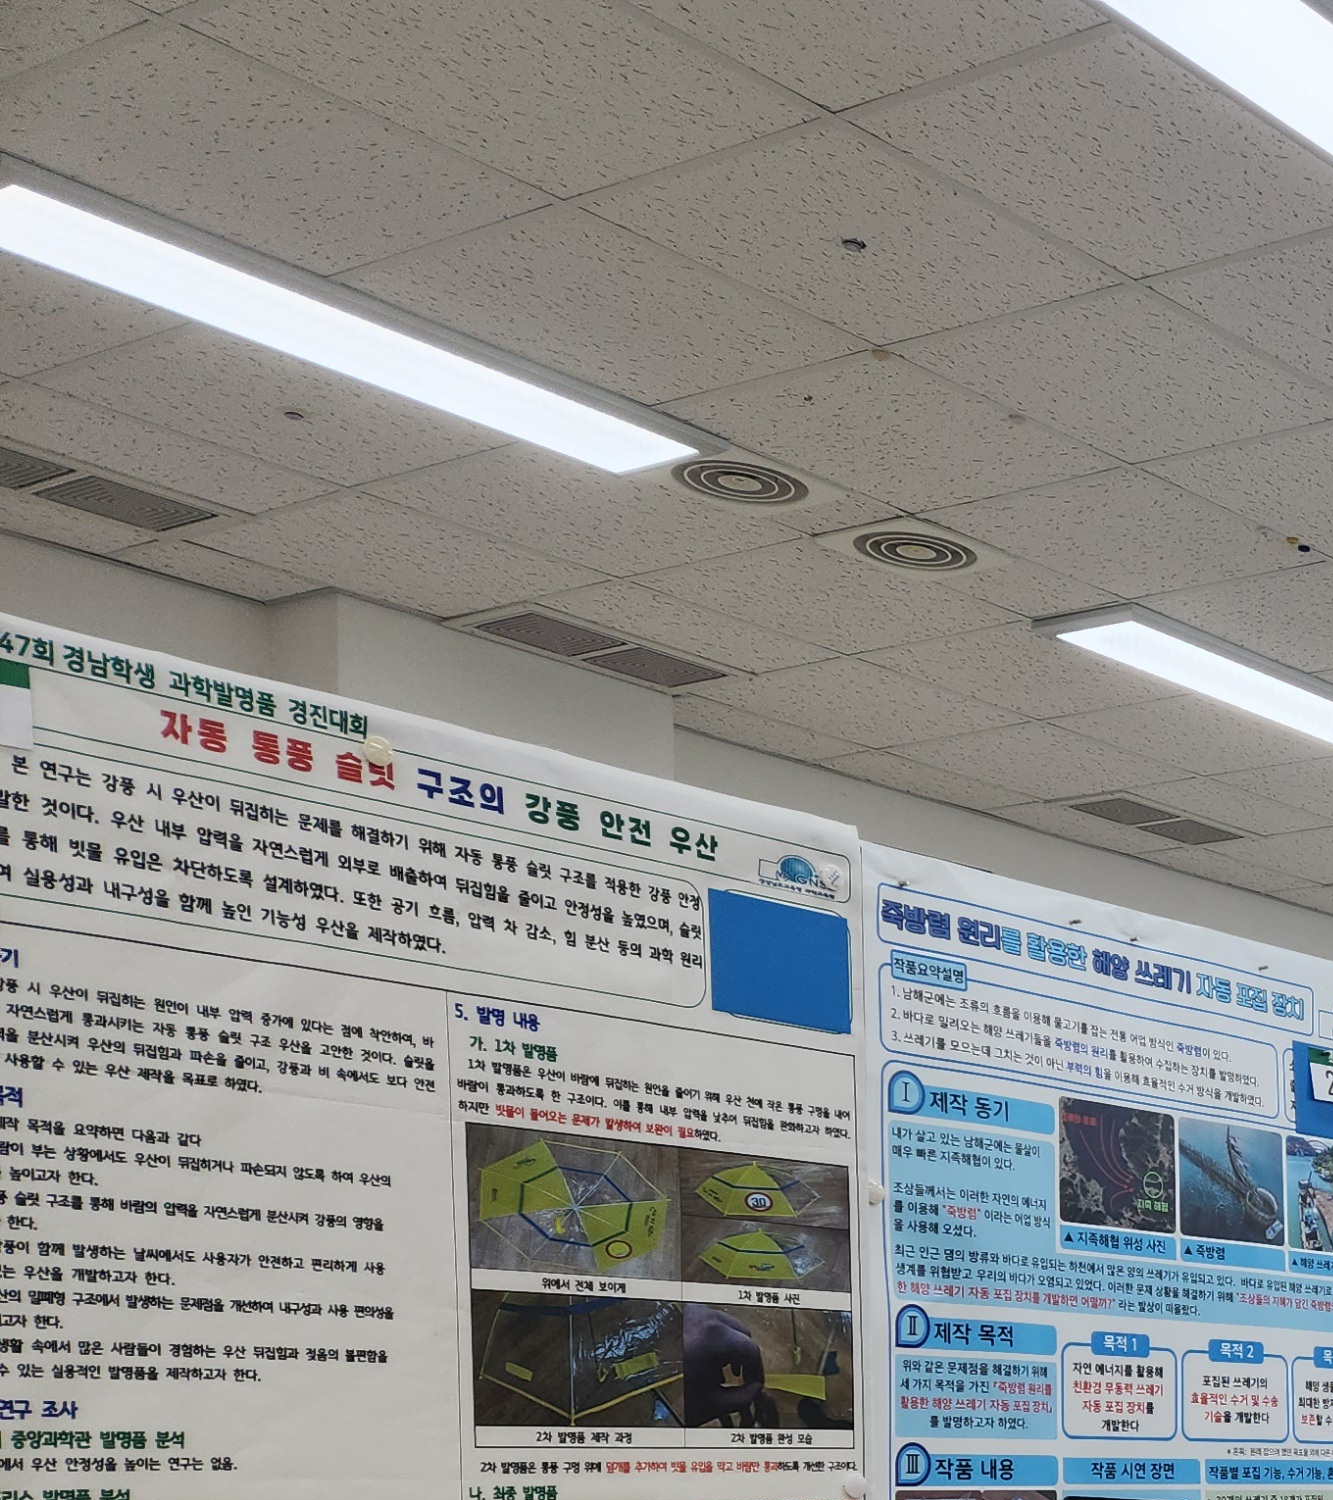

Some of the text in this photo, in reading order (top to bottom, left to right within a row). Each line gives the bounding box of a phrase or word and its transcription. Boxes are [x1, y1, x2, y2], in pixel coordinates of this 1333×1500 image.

[62, 643, 156, 691] 경남학생
[169, 670, 278, 717] 과학발명품
[287, 697, 370, 742] 경진대회
[160, 708, 227, 754] 자동
[251, 729, 314, 773] 통풍
[416, 766, 505, 816] 구조의
[525, 792, 580, 833] 강풍
[599, 809, 652, 849] 안전
[669, 825, 719, 863] 우산
[11, 753, 701, 912] 본 연구는 강풍 시 우산이 뒤집히는 문제를 해결하기 위해 자동 통풍 슬릿 구조를 적용한 강풍 안정
[881, 898, 1305, 1021] 죽방렴 원리를 활용한 해양 쓰레기 자동 포집 장치
[893, 956, 965, 984] 작품요약설명
[454, 1002, 541, 1033] 5. 발명 내용
[469, 1035, 558, 1064] 가. 1차 발명품
[930, 1090, 1010, 1122] 제작 동기
[1077, 1231, 1167, 1254] 지족해협 위성 사진
[1195, 1244, 1226, 1261] 죽방렴
[541, 1276, 627, 1295] 위에서 전체 보이게
[933, 1321, 1015, 1348] 제작 목적
[1102, 1335, 1137, 1352] 목적 1
[1219, 1343, 1254, 1359] 목적 2
[1073, 1379, 1164, 1398] 친환경 무동력 쓰레기
[10, 1429, 186, 1451] 중앙과학관 발명품 분석
[934, 1457, 1016, 1481] 작품 내용
[1090, 1460, 1175, 1481] 작품 시연 장면
